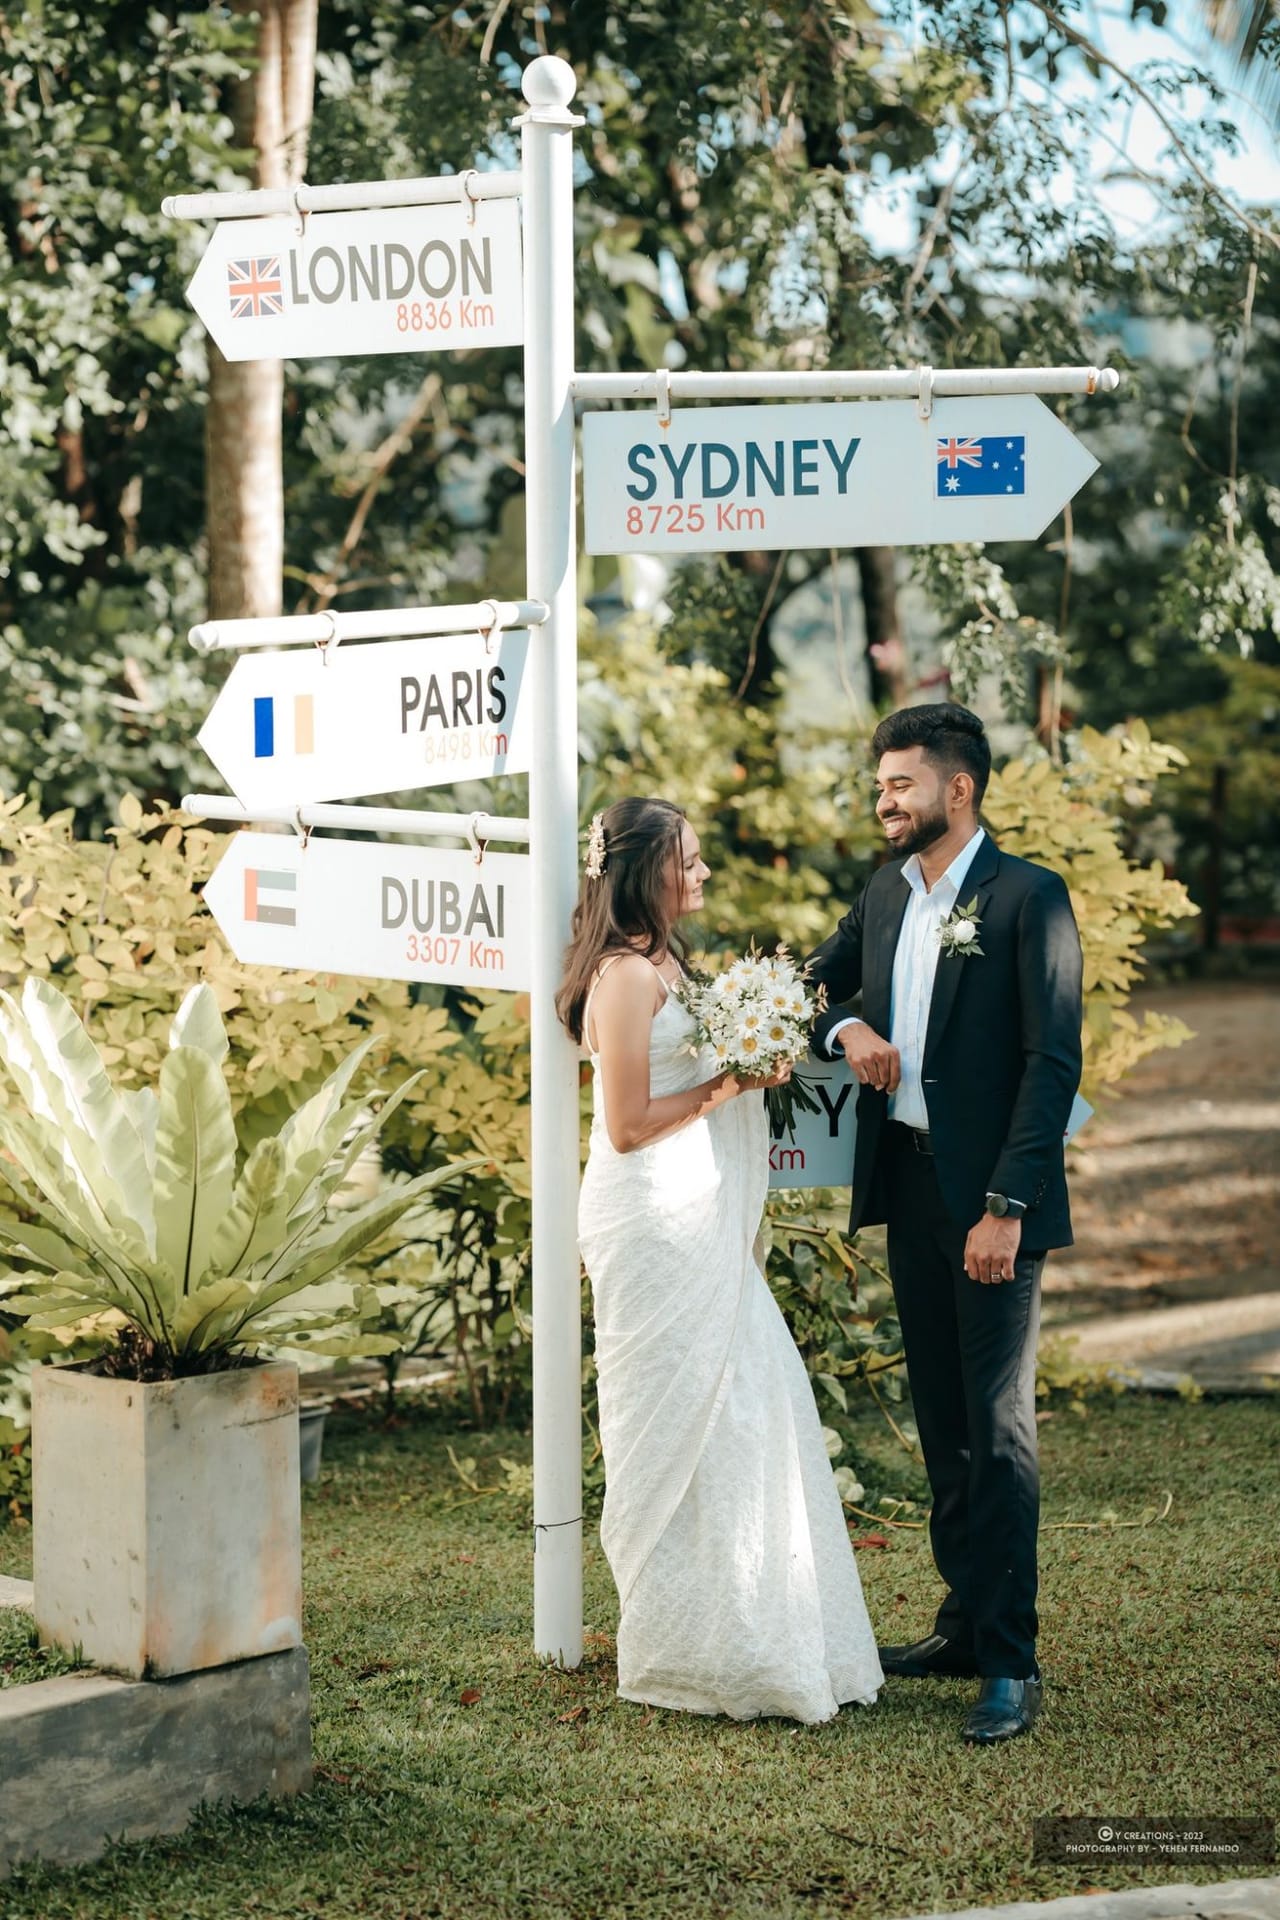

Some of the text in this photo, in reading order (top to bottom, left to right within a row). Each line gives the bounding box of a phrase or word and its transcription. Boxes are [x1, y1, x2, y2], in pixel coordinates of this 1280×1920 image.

[289, 236, 493, 305] LONDON
[397, 299, 494, 333] 8836 Km
[625, 438, 862, 502] SYDNEY
[626, 502, 765, 536] 8725 Km
[400, 665, 507, 734] PARIS
[423, 728, 508, 764] 8498 Km
[381, 876, 505, 939] DUBAI
[406, 934, 505, 971] 3307 Km
